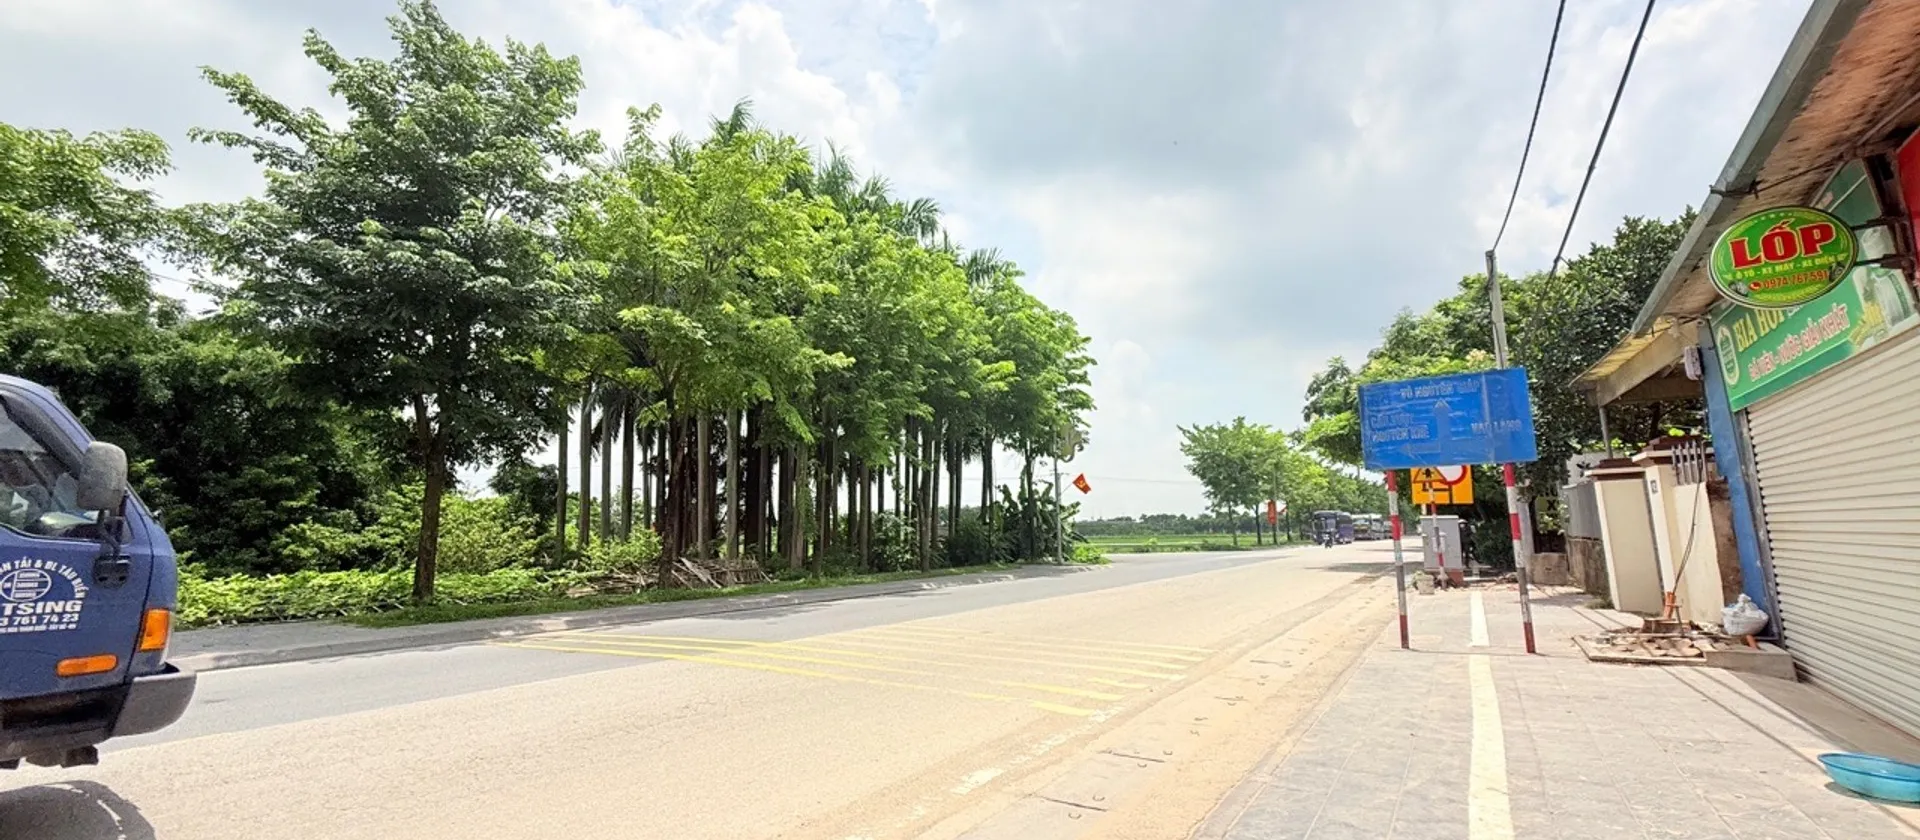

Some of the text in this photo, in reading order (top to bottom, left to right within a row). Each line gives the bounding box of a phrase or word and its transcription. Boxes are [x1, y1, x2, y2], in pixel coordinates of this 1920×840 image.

[1727, 218, 1836, 269] LỐP
[1732, 312, 1758, 352] BIA
[2, 600, 83, 616] TSING
[13, 615, 37, 625] 761
[62, 613, 79, 623] 23
